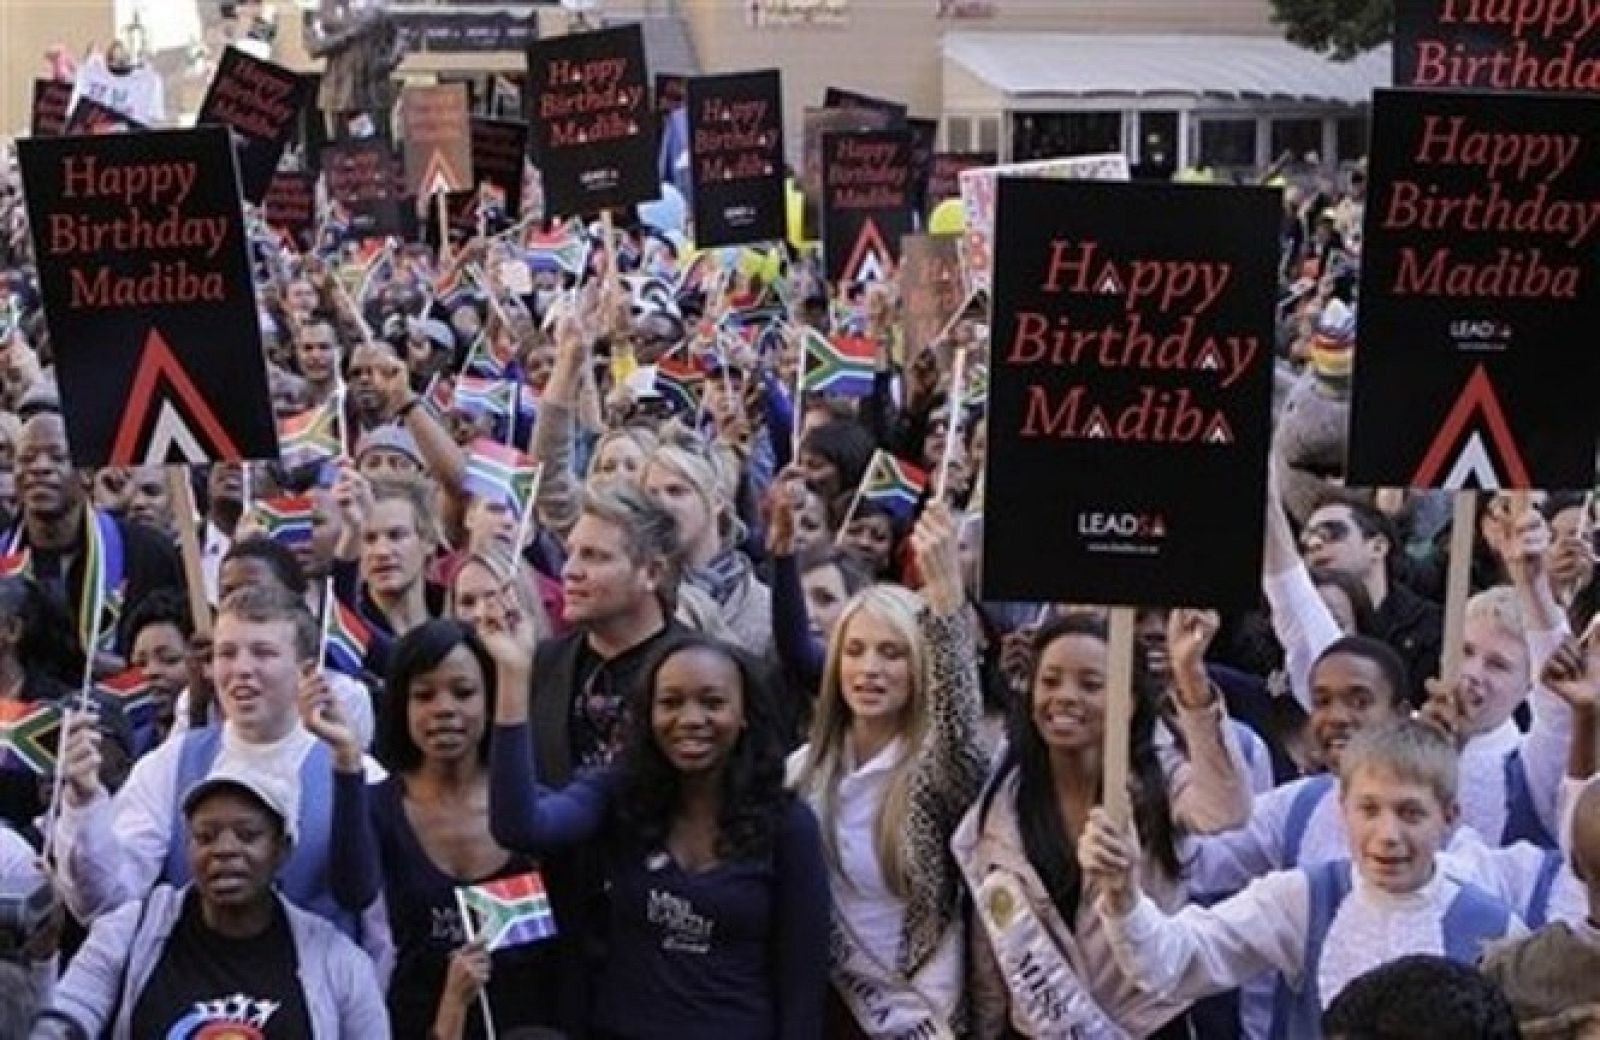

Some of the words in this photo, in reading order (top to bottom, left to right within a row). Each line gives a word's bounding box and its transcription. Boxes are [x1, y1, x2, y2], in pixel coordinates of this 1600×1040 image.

[1415, 115, 1580, 181] Happy
[62, 156, 196, 204] Happy
[48, 206, 227, 258] Birthday
[1384, 181, 1600, 248] Birthday
[70, 260, 225, 307] Madiba
[1393, 248, 1580, 297] Madiba
